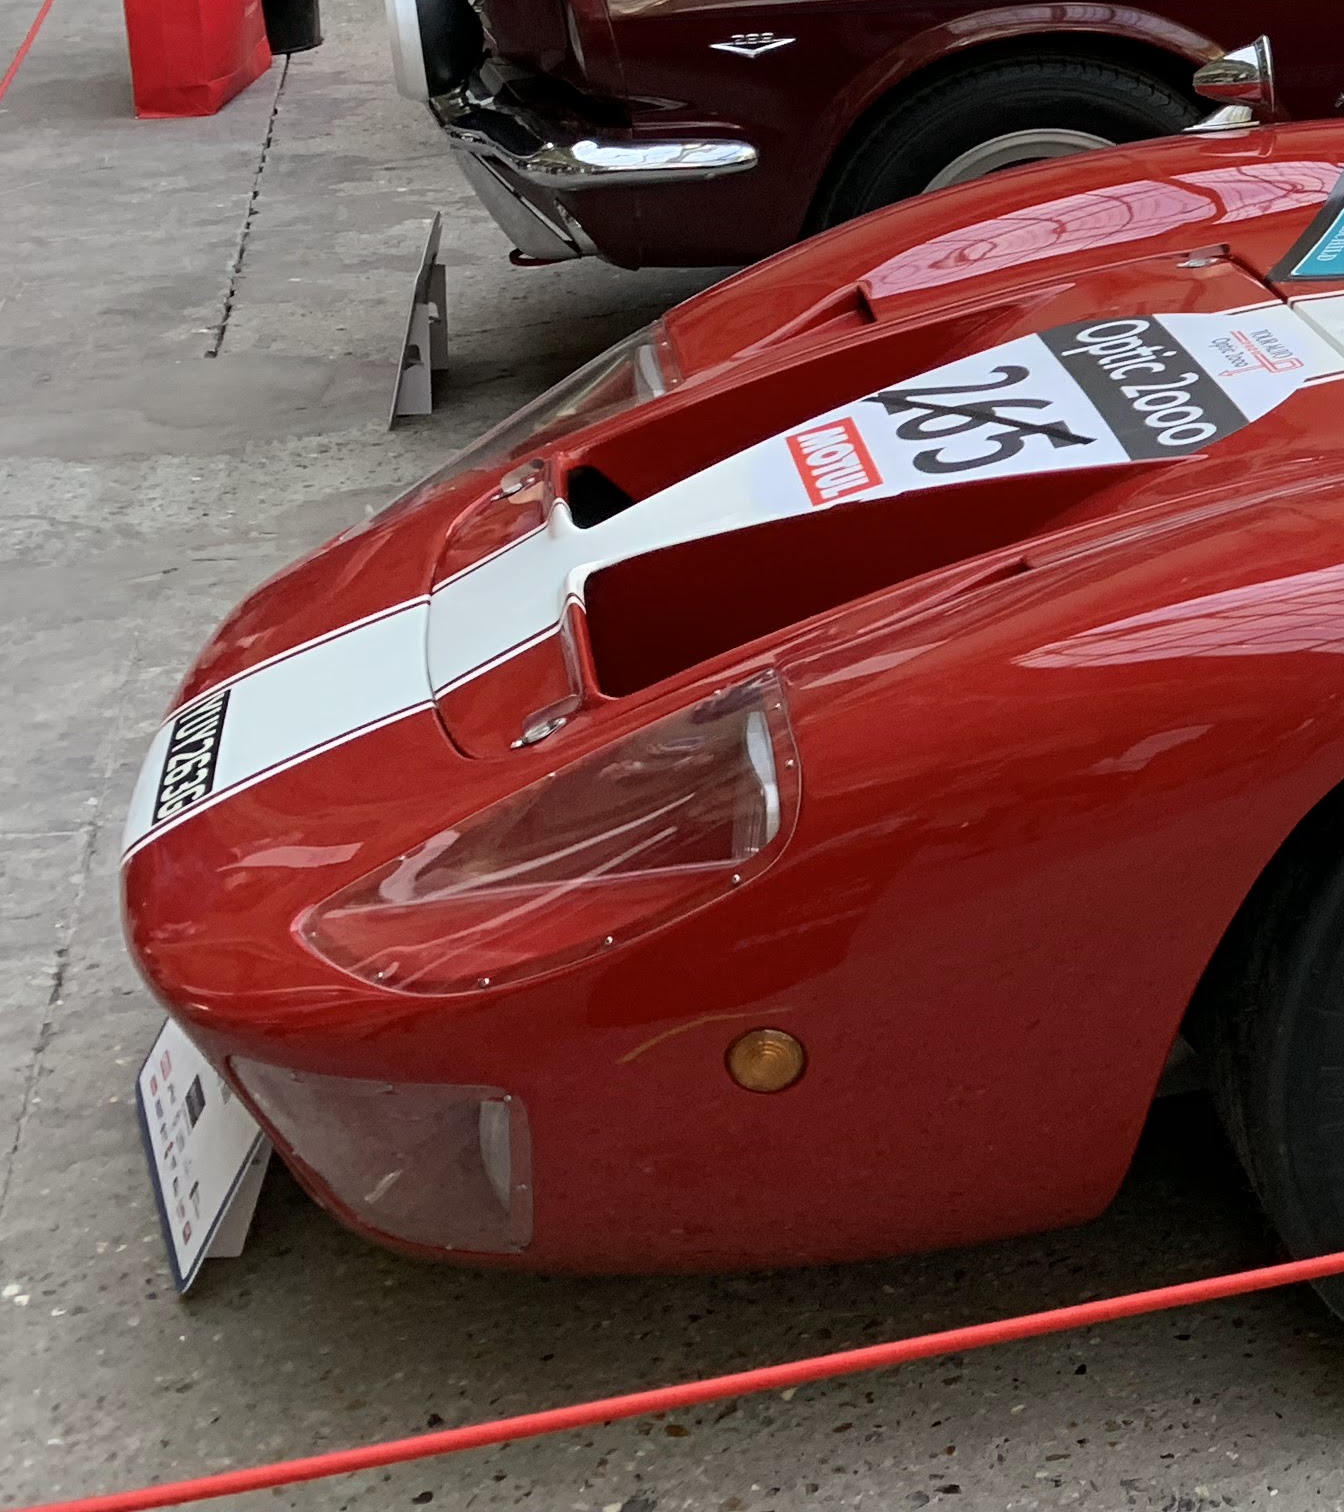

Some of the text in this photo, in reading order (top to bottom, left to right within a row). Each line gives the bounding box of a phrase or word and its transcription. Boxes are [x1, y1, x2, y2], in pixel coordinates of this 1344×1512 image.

[1061, 319, 1218, 448] Optic 2000
[1209, 337, 1235, 354] Optic
[797, 428, 869, 499] MOTUL
[873, 365, 1086, 474] 265
